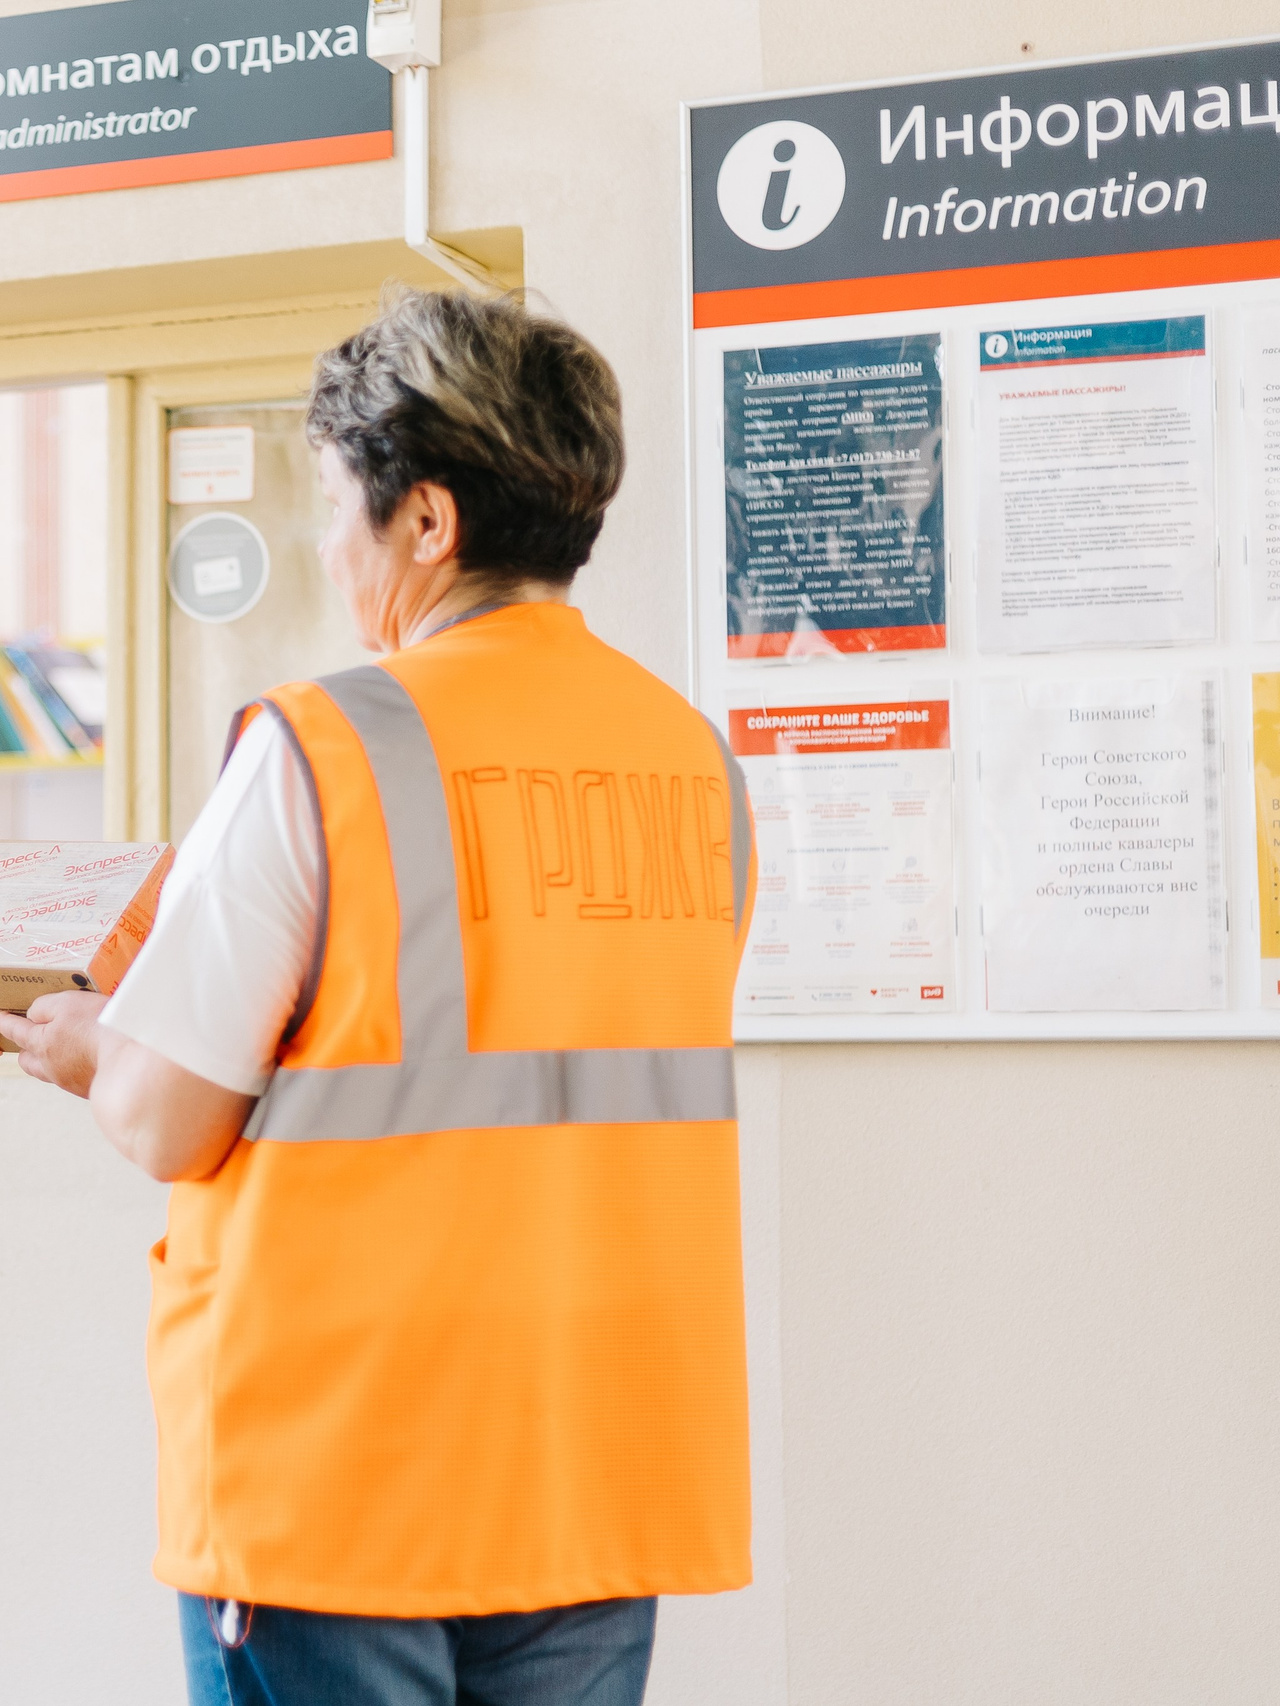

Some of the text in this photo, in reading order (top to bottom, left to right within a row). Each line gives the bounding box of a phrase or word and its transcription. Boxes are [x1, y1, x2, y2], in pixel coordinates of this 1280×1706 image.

[190, 25, 359, 76] отдыха
[880, 79, 1280, 167] Информац
[883, 171, 1207, 240] Information
[1014, 328, 1092, 344] Информация
[744, 361, 922, 385] Уважаемые пассажиры
[999, 390, 1059, 400] УВАЖАЕМЫЕ
[747, 709, 929, 730] СОХРАНИТЕ ВАШЕ ЗДОРОВЬЕ
[1069, 705, 1156, 722] Внимание!
[1041, 748, 1187, 769] Герои Советского
[1085, 771, 1142, 787] Союза,
[1041, 791, 1189, 812] Герои Российской
[1070, 816, 1160, 832] Федерации
[1038, 836, 1195, 854] и полные кавалеры
[64, 844, 159, 877] Экспресс-Л
[1059, 858, 1173, 877] ордена Славы
[1036, 880, 1198, 899] обслуживаются вне
[1084, 904, 1149, 920] очереди
[1, 975, 44, 983] 6994010
